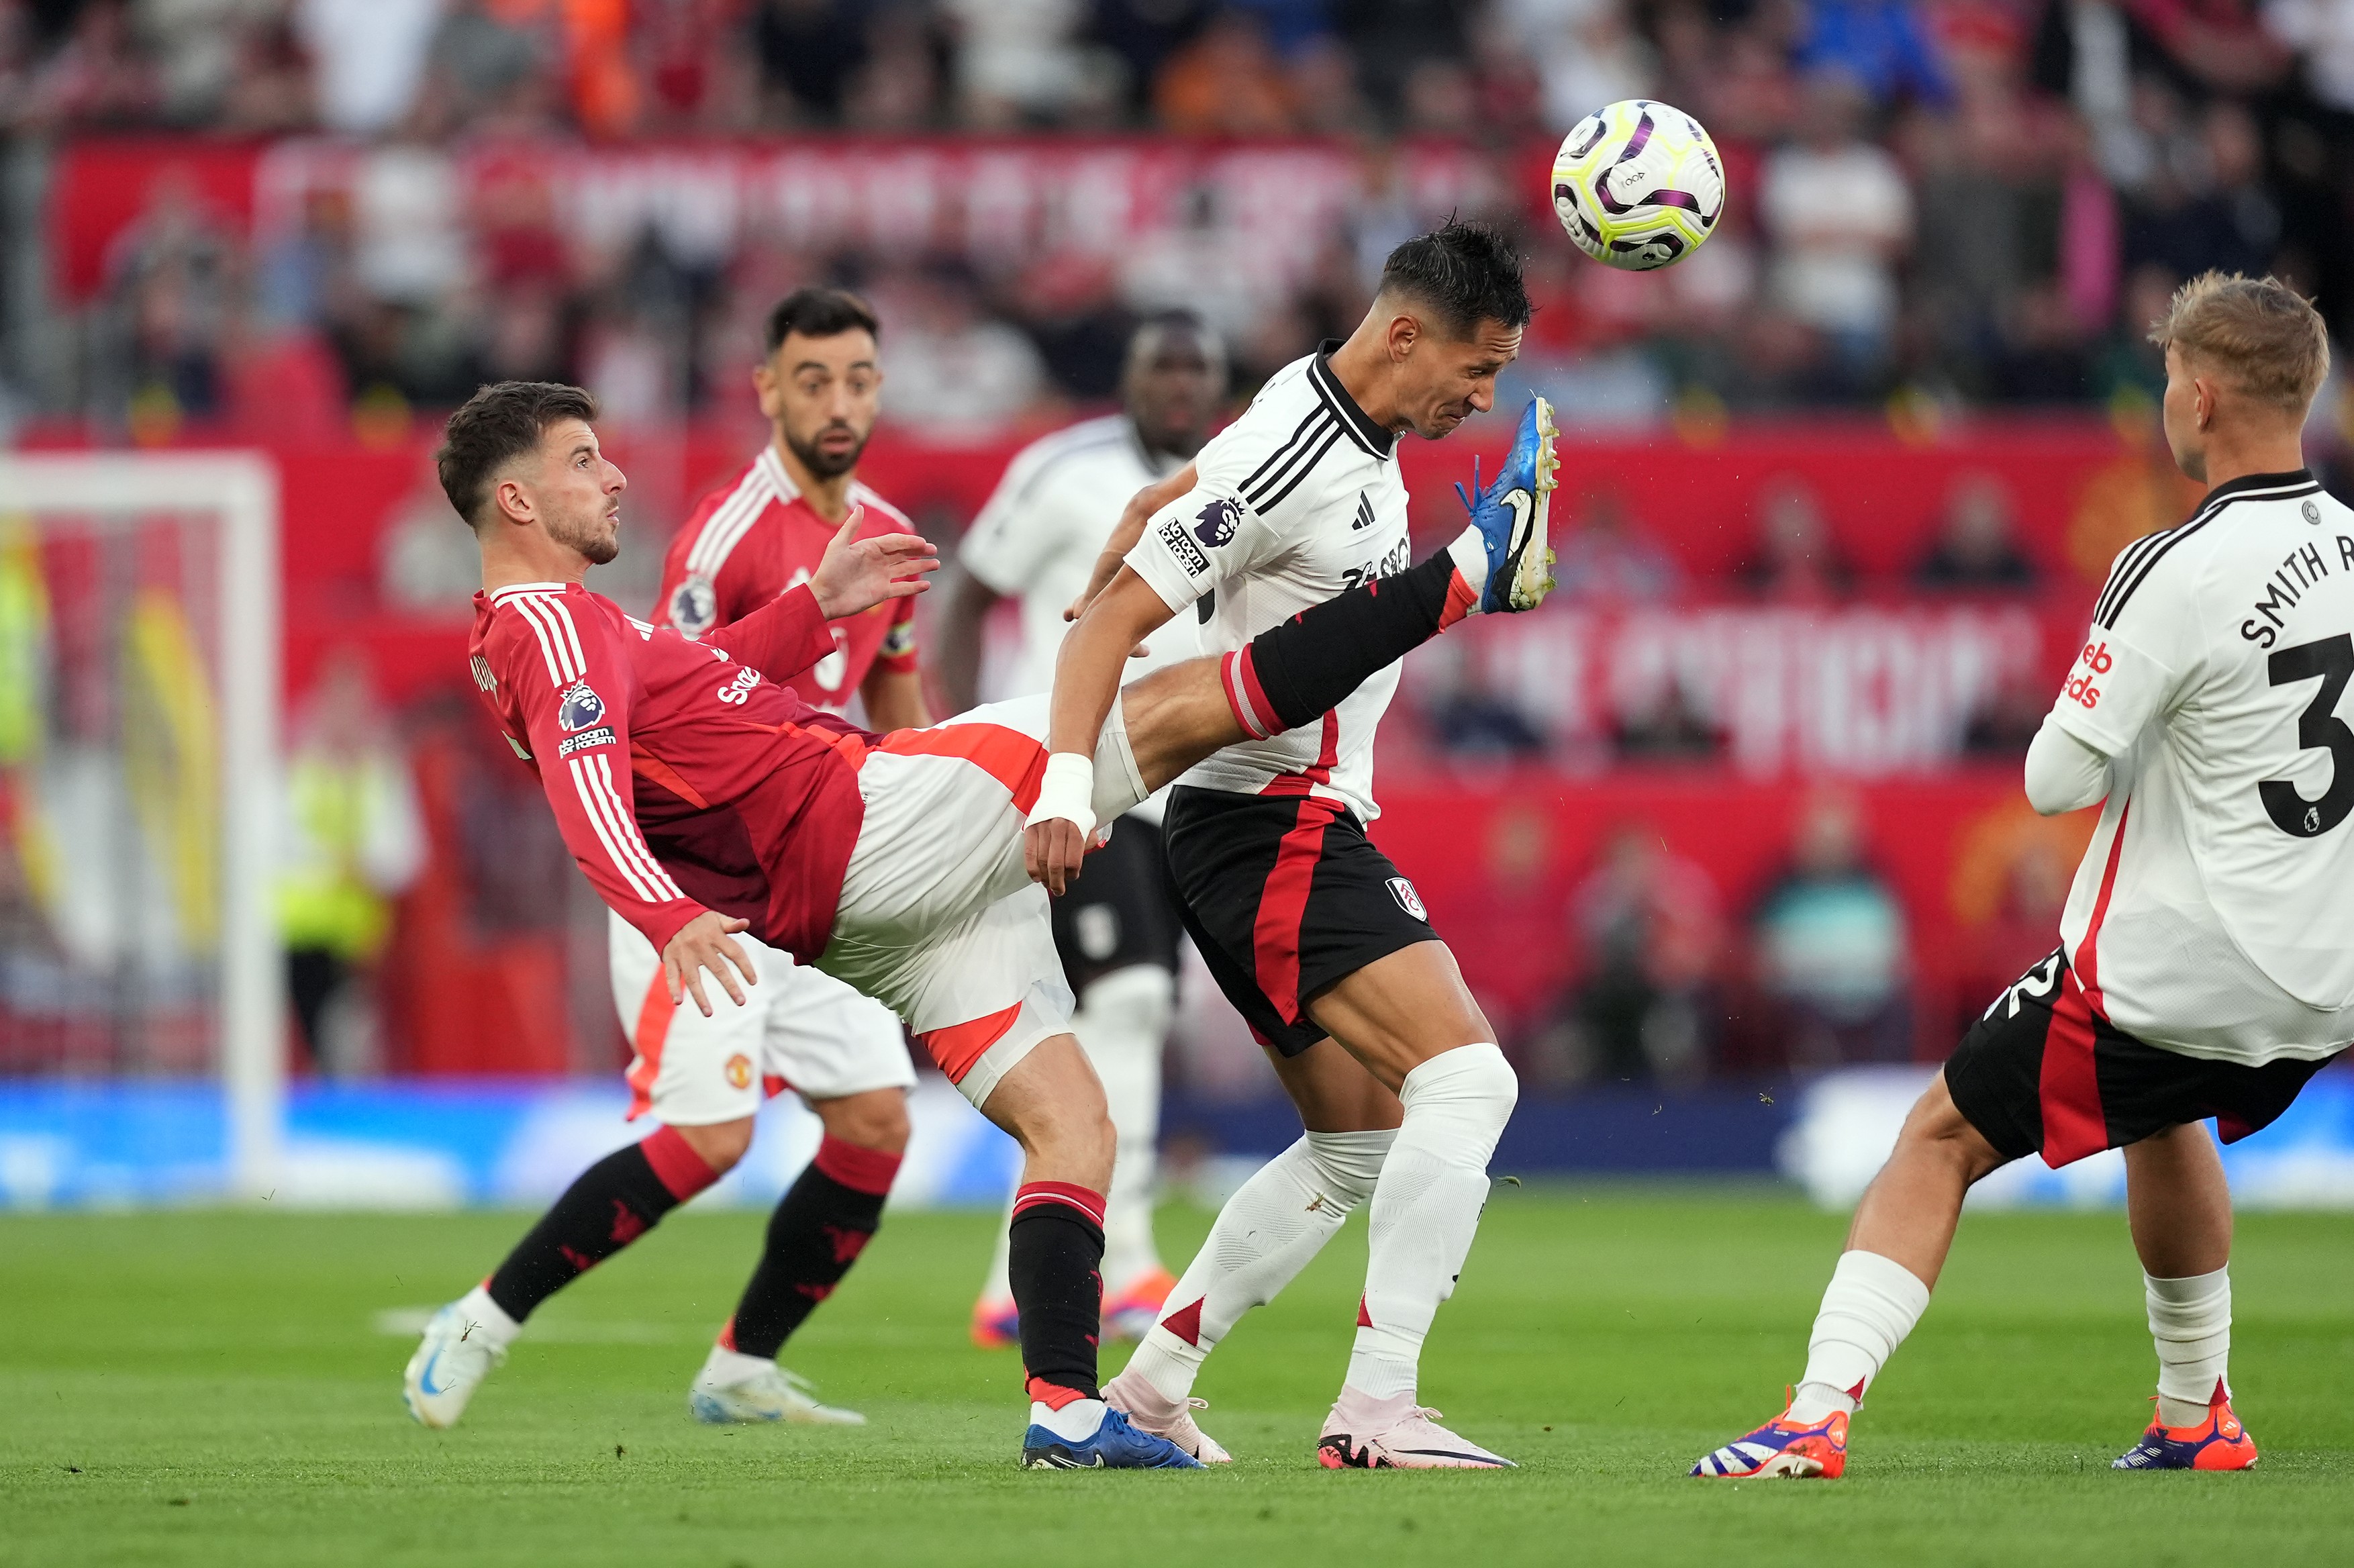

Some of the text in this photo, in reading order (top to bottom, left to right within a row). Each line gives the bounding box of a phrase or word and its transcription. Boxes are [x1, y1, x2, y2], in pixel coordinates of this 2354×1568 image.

[1157, 524, 1199, 578] for racism
[1164, 518, 1204, 568] No room
[2241, 541, 2328, 649] SMITH
[2082, 642, 2112, 675] eb
[574, 728, 609, 743] room
[575, 735, 617, 750] racism
[2258, 632, 2354, 838] 3
[1400, 883, 1420, 912] FFC
